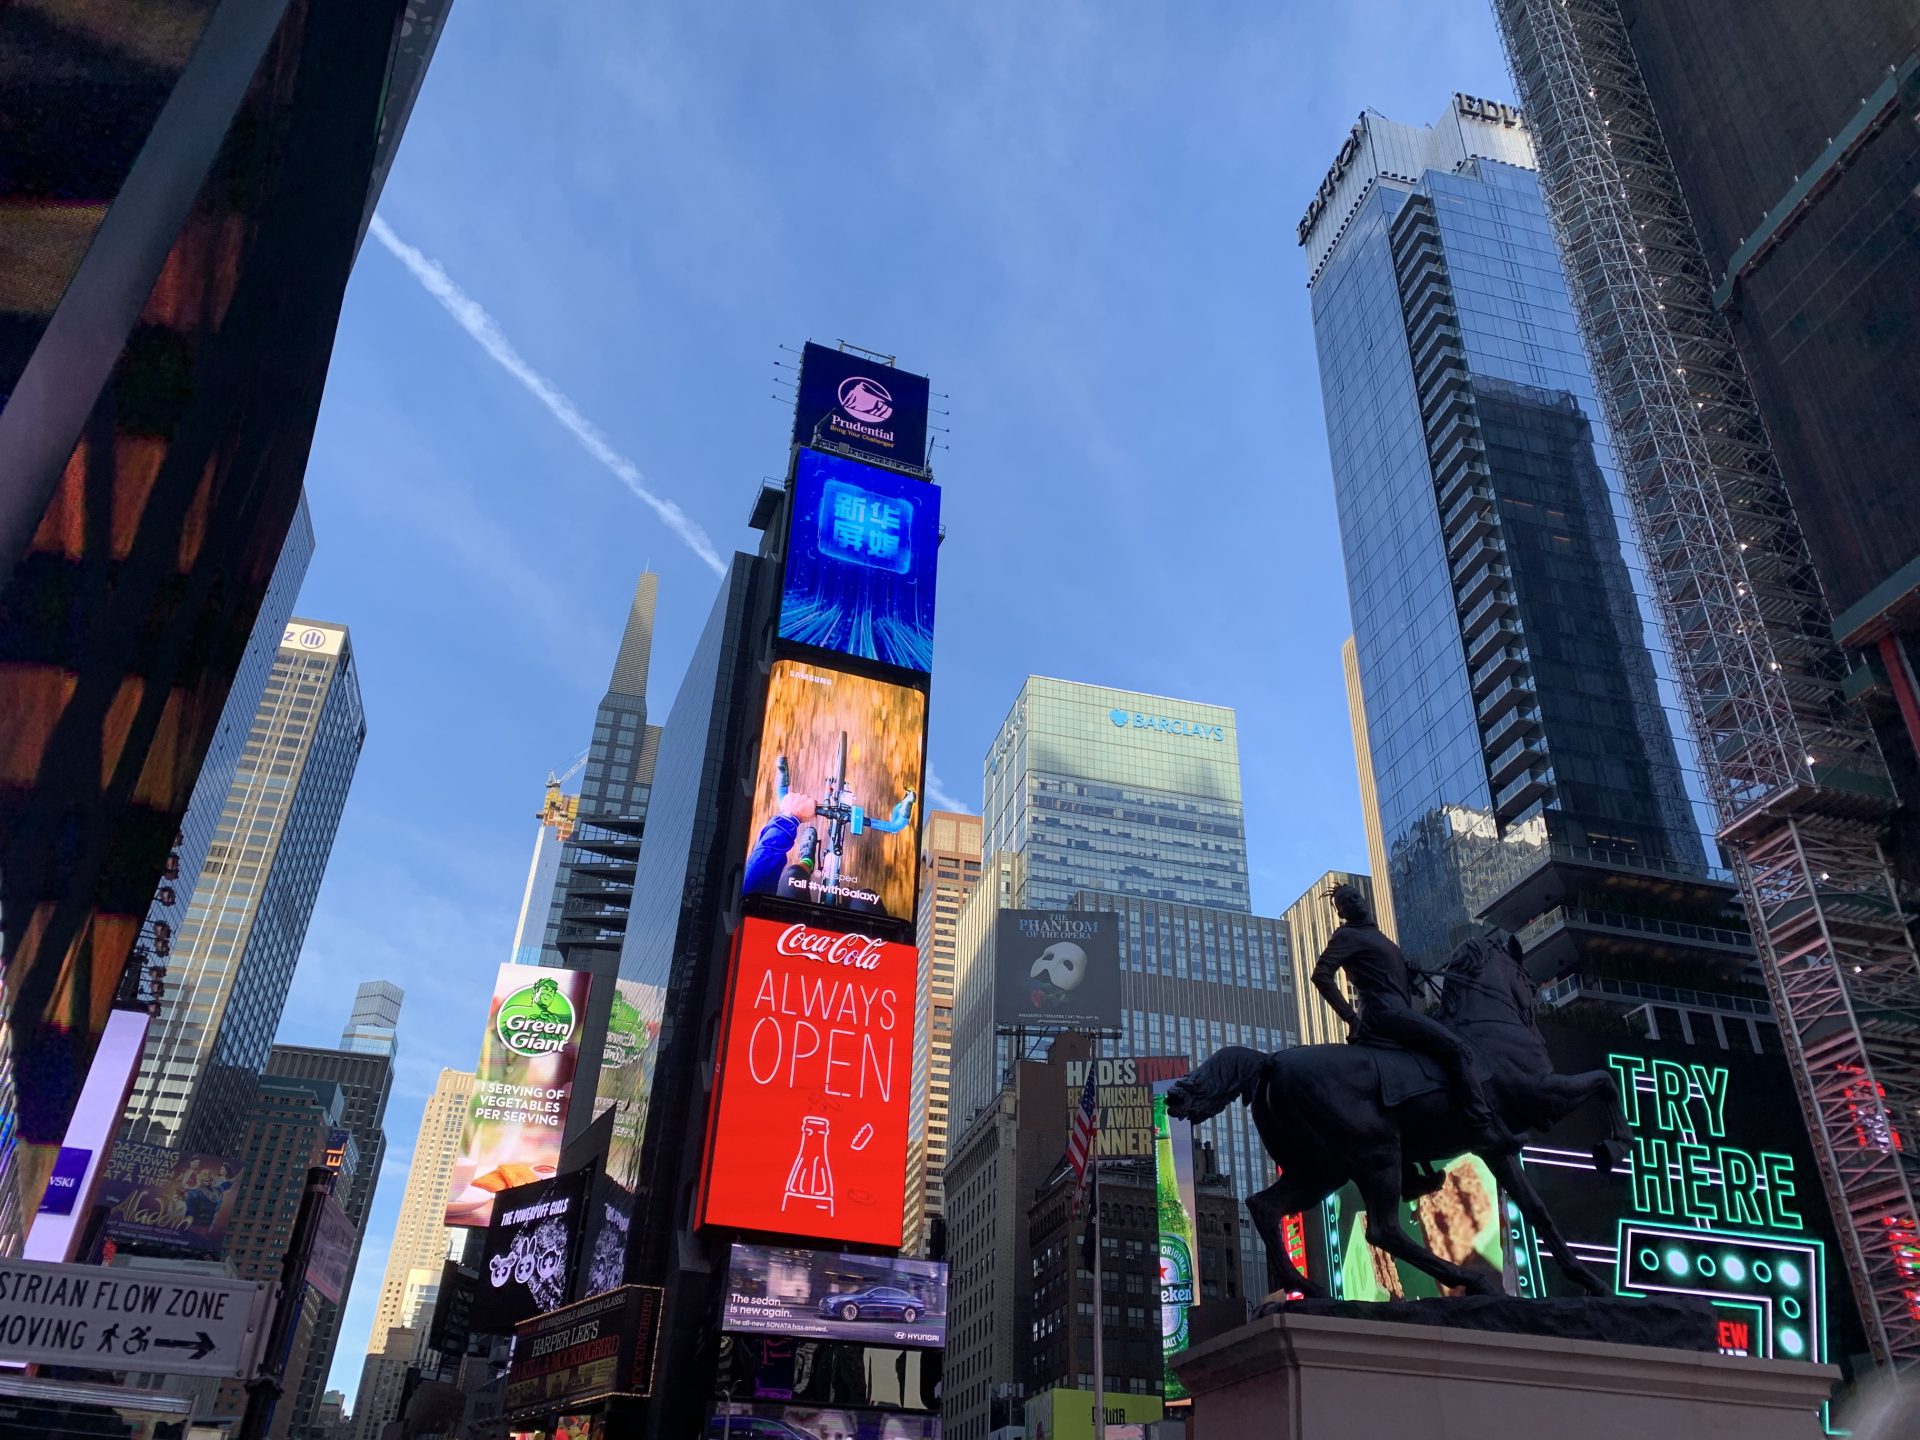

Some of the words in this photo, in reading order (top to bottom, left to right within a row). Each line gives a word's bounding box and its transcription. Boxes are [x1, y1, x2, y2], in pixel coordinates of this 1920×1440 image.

[830, 424, 847, 435] Bring
[848, 430, 860, 438] Your
[832, 414, 894, 441] Prudential
[789, 670, 832, 686] SAMSUNG
[1132, 711, 1225, 742] BARCLAYS
[788, 877, 807, 889] Fall
[808, 881, 880, 905] #withGalaxy
[1019, 919, 1099, 934] PHANTOM
[1048, 913, 1069, 921] THE
[1026, 930, 1039, 938] OF
[1041, 931, 1061, 939] THE
[1060, 931, 1092, 940] OPERA
[754, 969, 897, 1031] ALWAYS
[506, 1014, 570, 1036] Green
[510, 1031, 569, 1053] Giant
[749, 1016, 894, 1103] OPEN
[487, 1083, 543, 1098] SERVING
[545, 1088, 565, 1101] OF
[1098, 1086, 1151, 1107] MUSICAL
[1608, 1053, 1729, 1138] TRY
[480, 1095, 561, 1113] VEGETABLES
[475, 1107, 500, 1121] PER
[502, 1110, 559, 1126] SERVING
[1068, 1107, 1103, 1129] TY
[1106, 1107, 1152, 1129] AWARD
[113, 1140, 180, 1161] DAZZLING
[1068, 1128, 1153, 1155] INNER
[107, 1159, 135, 1172] ONE
[139, 1165, 175, 1178] WISH
[110, 1151, 178, 1169] BROADWAY
[326, 1142, 346, 1176] EL
[103, 1170, 121, 1180] AT
[122, 1173, 132, 1183] A
[1630, 1136, 1804, 1231] HERE
[501, 1211, 514, 1226] THE
[513, 1202, 550, 1224] POWERPUFF
[549, 1198, 569, 1216] GIRLS
[1161, 1245, 1188, 1274] ORIGINAL
[93, 1281, 163, 1314] FLOW
[165, 1288, 230, 1321] ZONE
[603, 1292, 627, 1310] CLASSIC
[731, 1293, 749, 1304] The
[750, 1296, 781, 1306] sedan
[1161, 1287, 1192, 1303] eken
[730, 1303, 738, 1313] is
[739, 1306, 761, 1315] new
[762, 1308, 792, 1318] again.
[729, 1318, 741, 1326] The
[741, 1320, 766, 1328] all-new
[766, 1321, 792, 1330] SONATA
[792, 1323, 804, 1331] has
[804, 1324, 829, 1333] arrived.
[1716, 1321, 1748, 1350] EW
[531, 1329, 572, 1358] HARPER
[570, 1319, 600, 1345] LEE'S
[907, 1332, 940, 1342] HYUNDAI
[551, 1334, 620, 1370] MOCKINGBIRD
